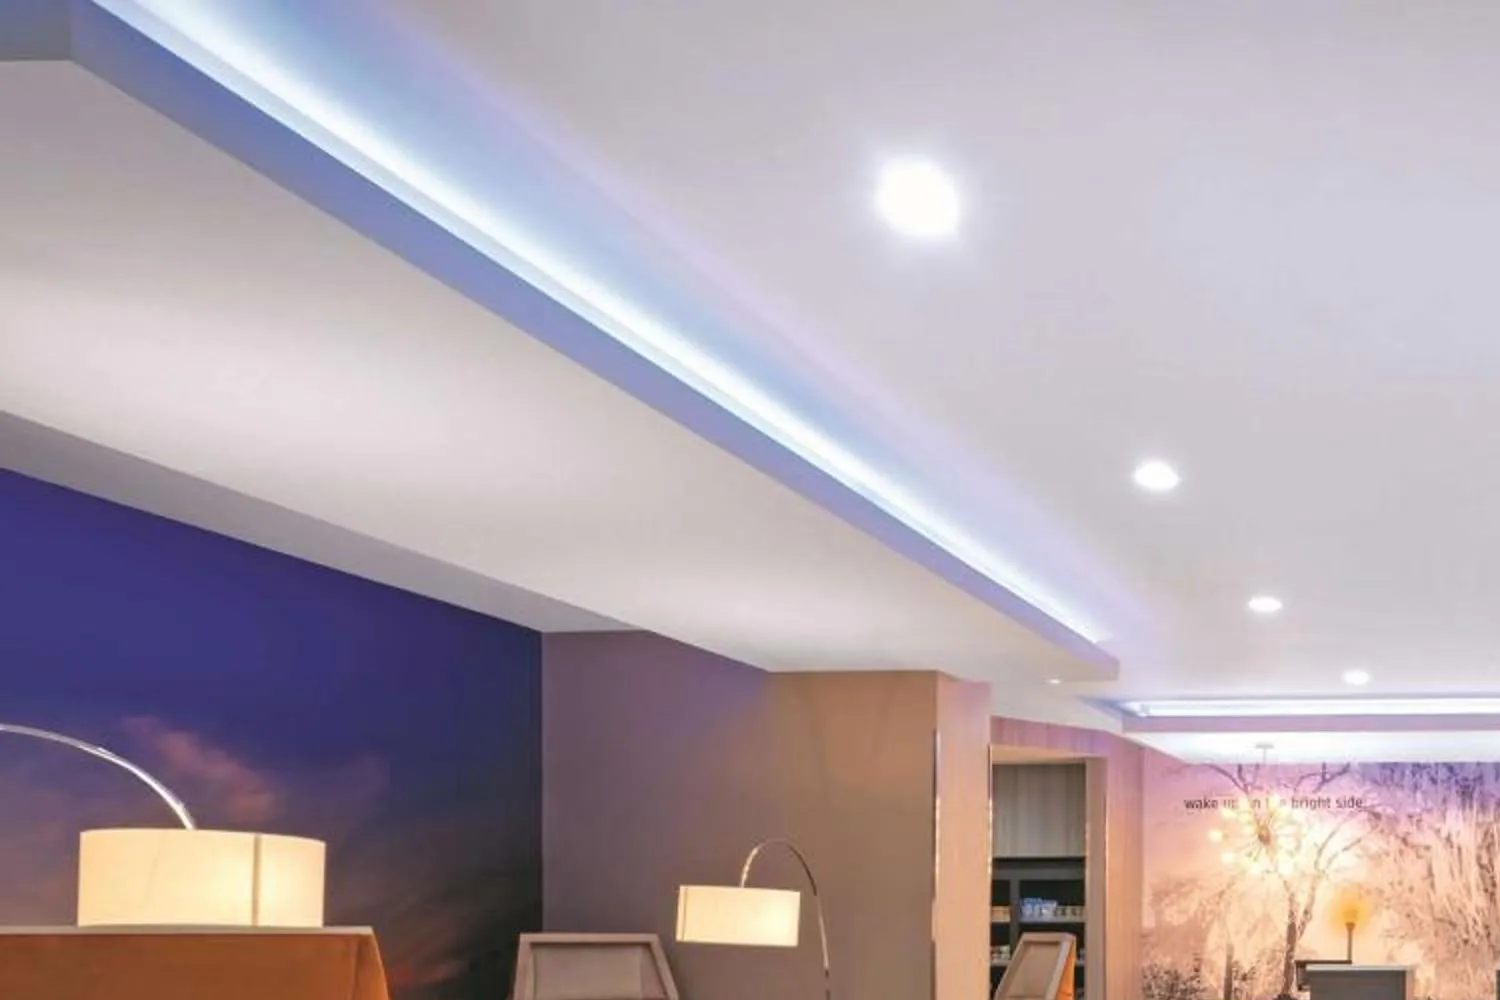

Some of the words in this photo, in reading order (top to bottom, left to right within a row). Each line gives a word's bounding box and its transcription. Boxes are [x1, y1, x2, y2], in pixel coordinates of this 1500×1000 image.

[1184, 795, 1218, 809] wake
[1291, 796, 1331, 811] bright
[1335, 795, 1363, 809] side
